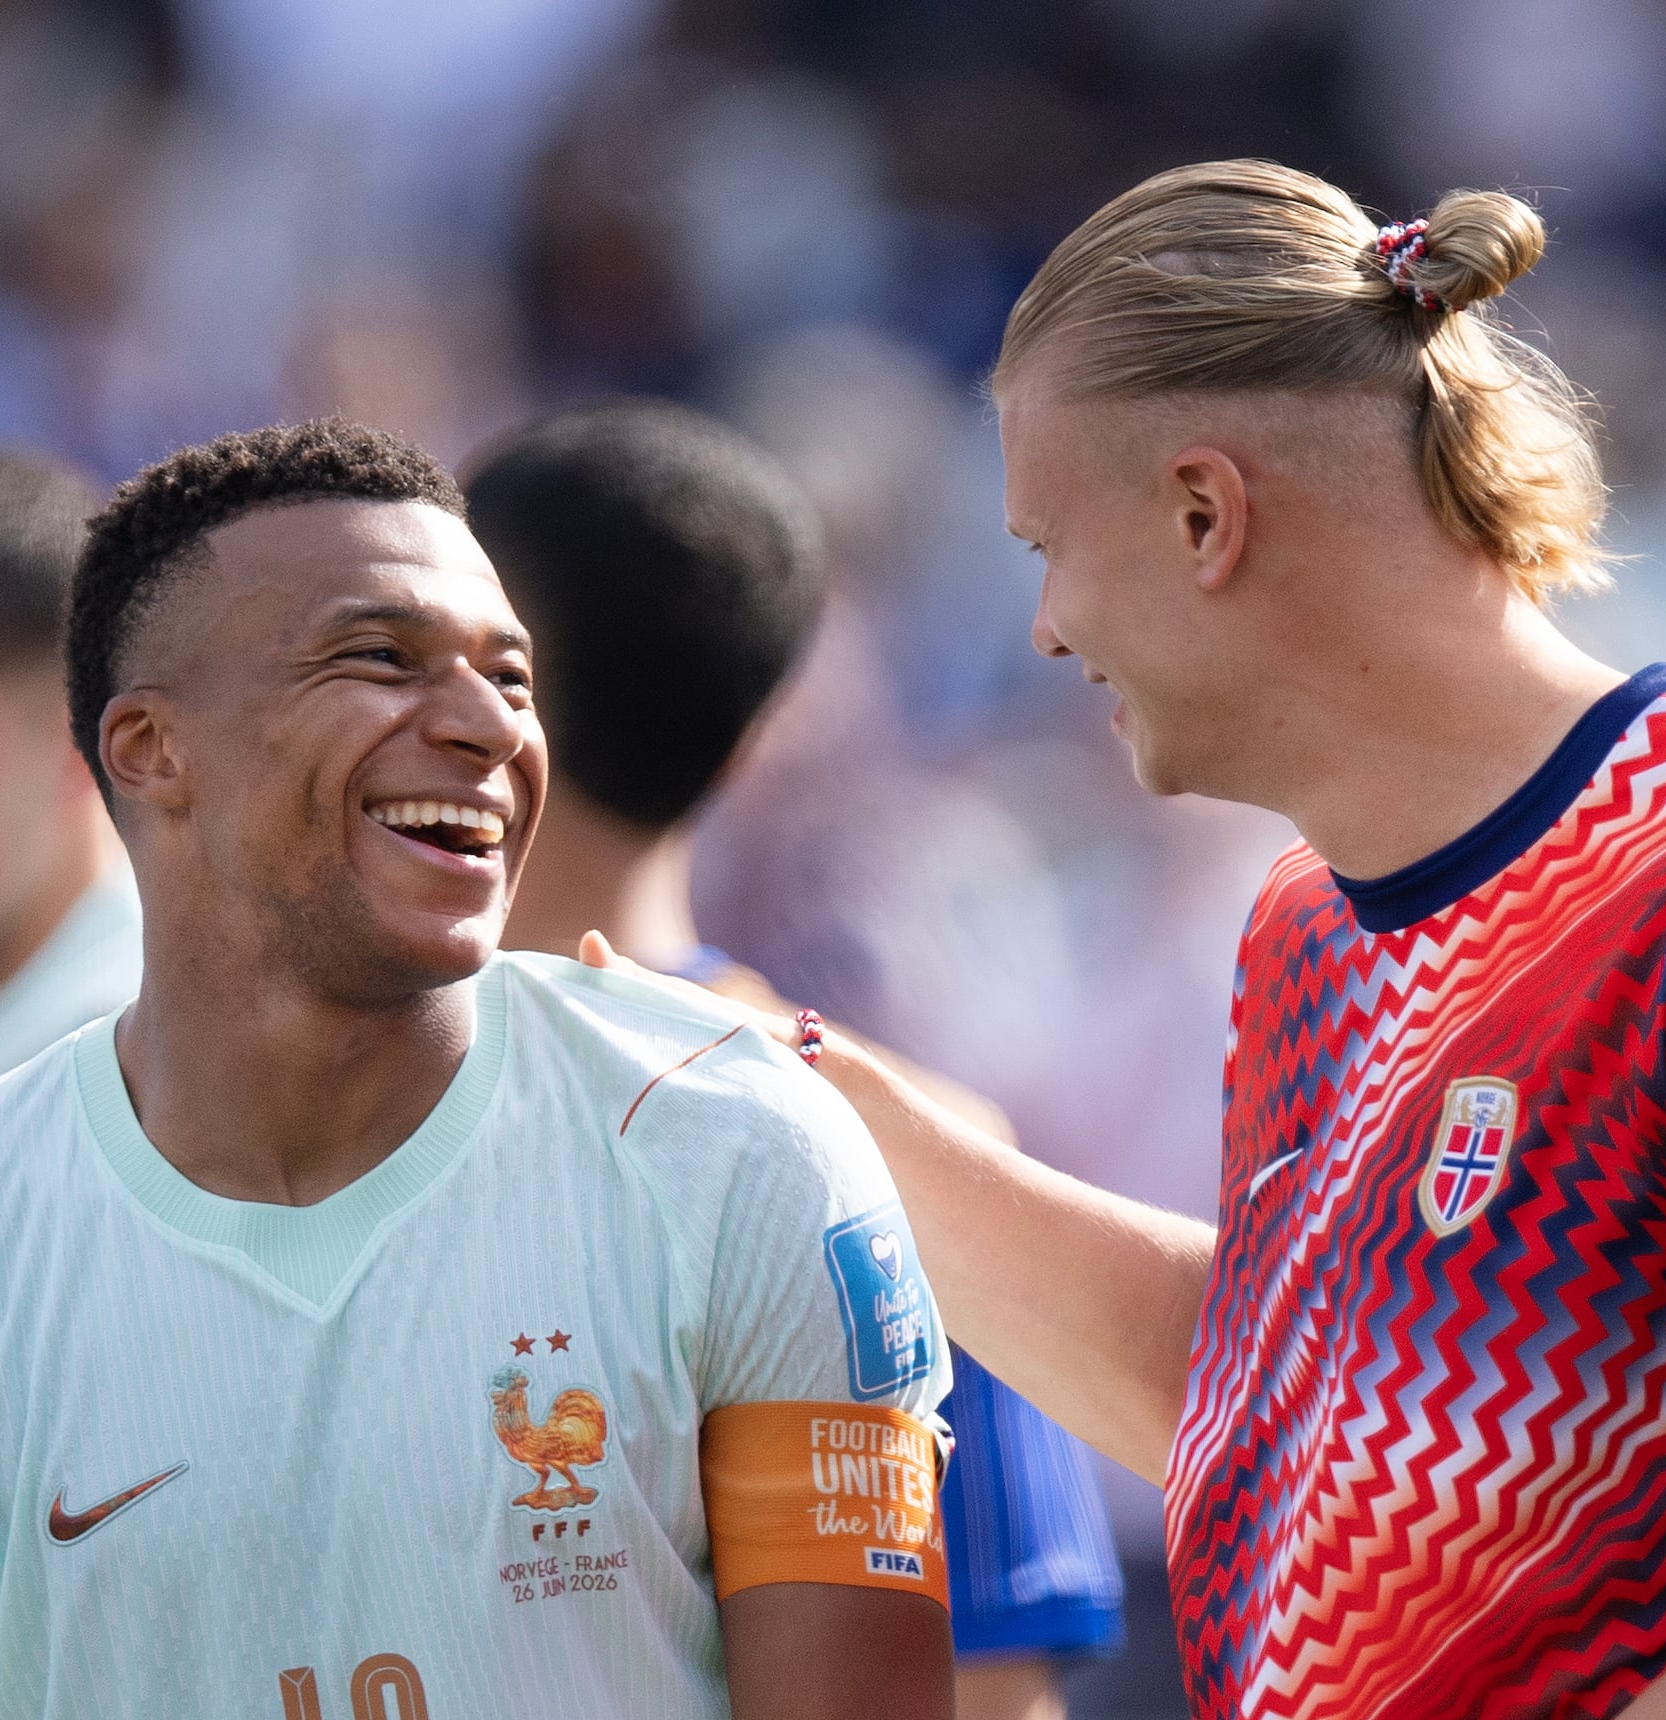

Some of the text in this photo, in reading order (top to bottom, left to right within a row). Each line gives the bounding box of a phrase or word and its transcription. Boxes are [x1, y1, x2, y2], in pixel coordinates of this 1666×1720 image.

[882, 1309, 924, 1355] PEACE
[810, 1417, 930, 1471] FOOTBALL
[812, 1452, 935, 1515] UNITES
[807, 1499, 869, 1536] the
[575, 1549, 628, 1572] FRANCE
[870, 1551, 921, 1575] FIFA
[512, 1573, 618, 1603] 26 JUIN 2026
